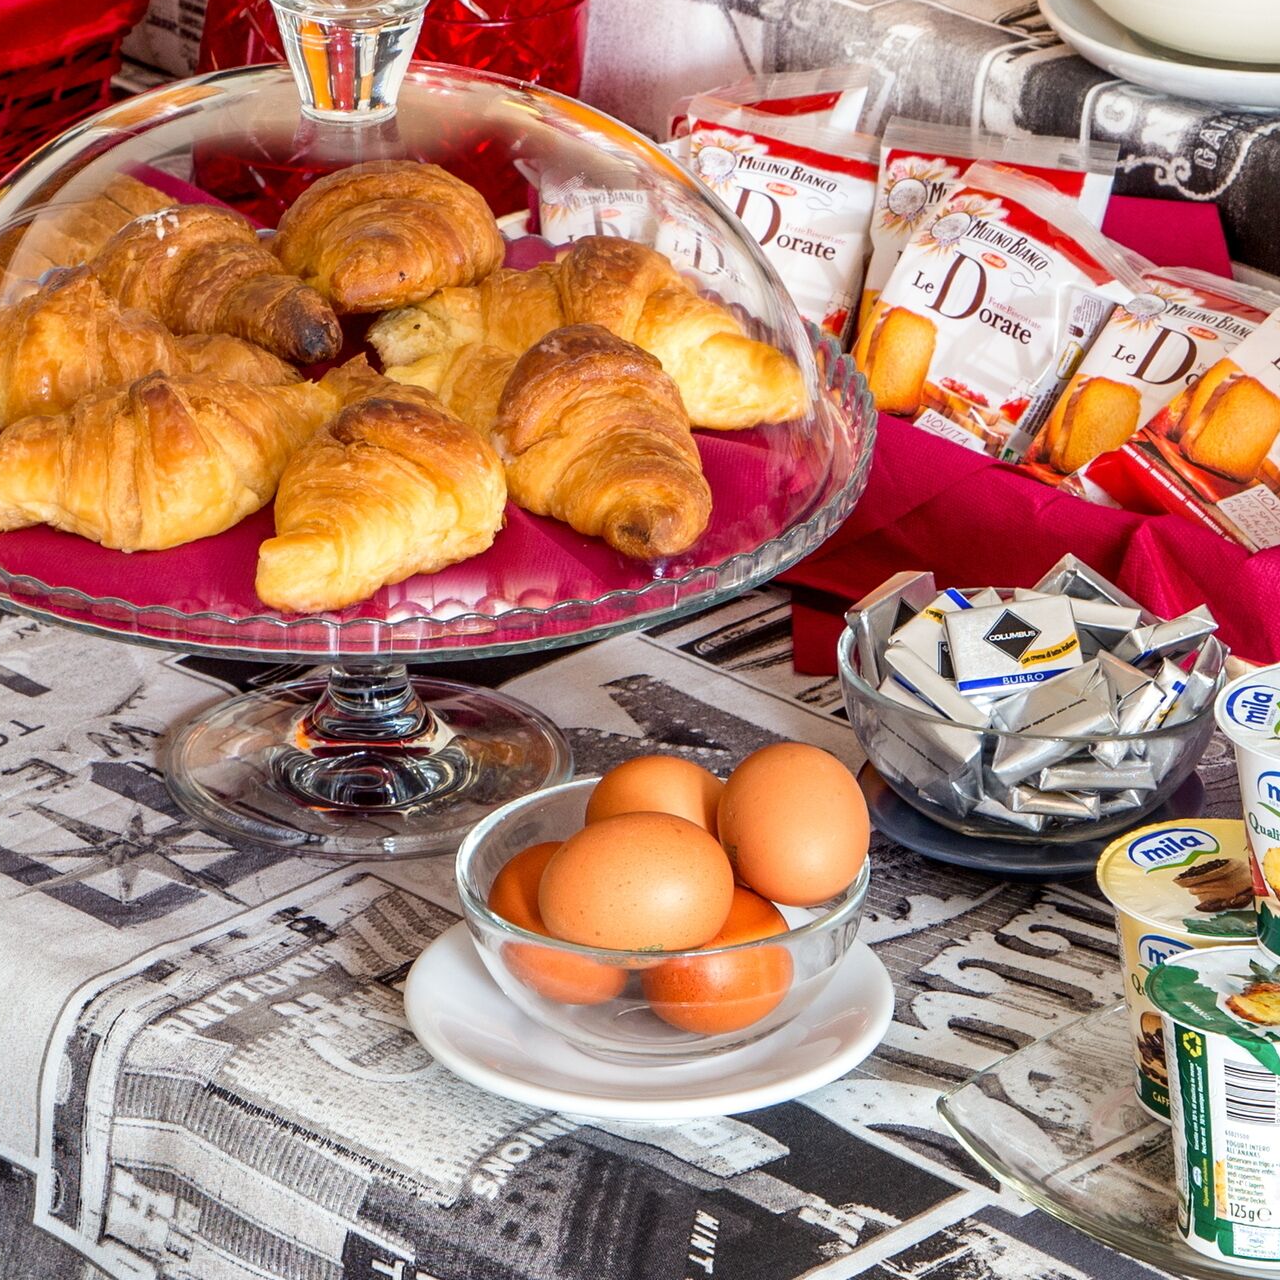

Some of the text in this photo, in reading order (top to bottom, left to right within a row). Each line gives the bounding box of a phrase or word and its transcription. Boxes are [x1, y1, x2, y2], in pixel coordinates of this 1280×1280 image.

[738, 155, 838, 193] MULINO BIANCO
[966, 220, 1049, 271] MULINO BIANCO
[911, 270, 935, 294] Le
[924, 251, 1033, 346] Dorate
[1166, 303, 1219, 326] MULINO
[1111, 344, 1136, 365] Le
[988, 630, 1037, 642] COLUMBUS
[1002, 673, 1045, 685] BURRO
[1244, 690, 1274, 725] mila
[1139, 834, 1205, 863] mila
[1227, 1140, 1270, 1152] YOGURT INTERO
